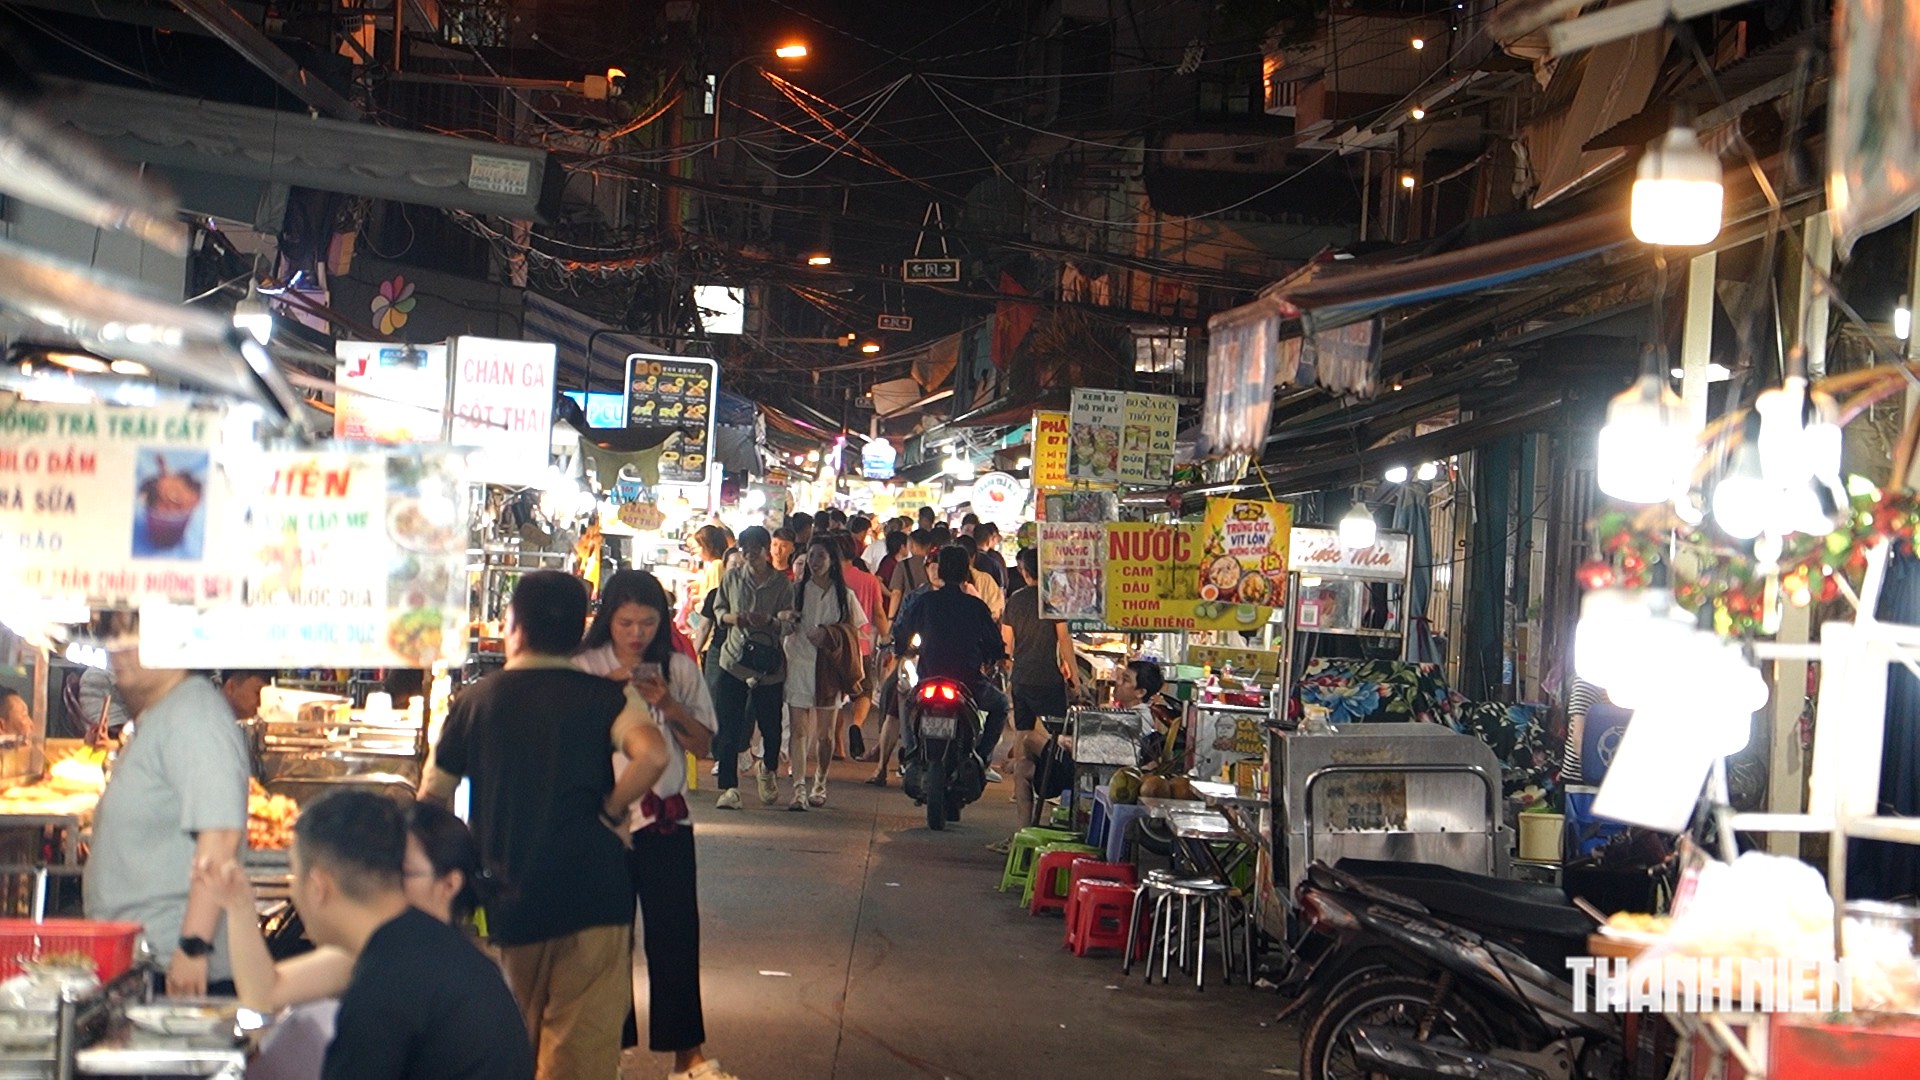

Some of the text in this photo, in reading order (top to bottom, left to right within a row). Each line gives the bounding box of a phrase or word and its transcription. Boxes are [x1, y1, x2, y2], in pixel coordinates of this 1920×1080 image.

[1082, 393, 1102, 402] KEM
[0, 405, 48, 436] ỒNG
[1041, 418, 1067, 433] PHÁ
[0, 449, 39, 474] ILO
[1121, 467, 1144, 476] NON
[1109, 525, 1191, 562] NƯỚC
[1122, 566, 1153, 577] CAM
[1122, 581, 1150, 594] DÂU
[1122, 599, 1160, 611] THƠM
[1153, 615, 1195, 628] RIÊNG
